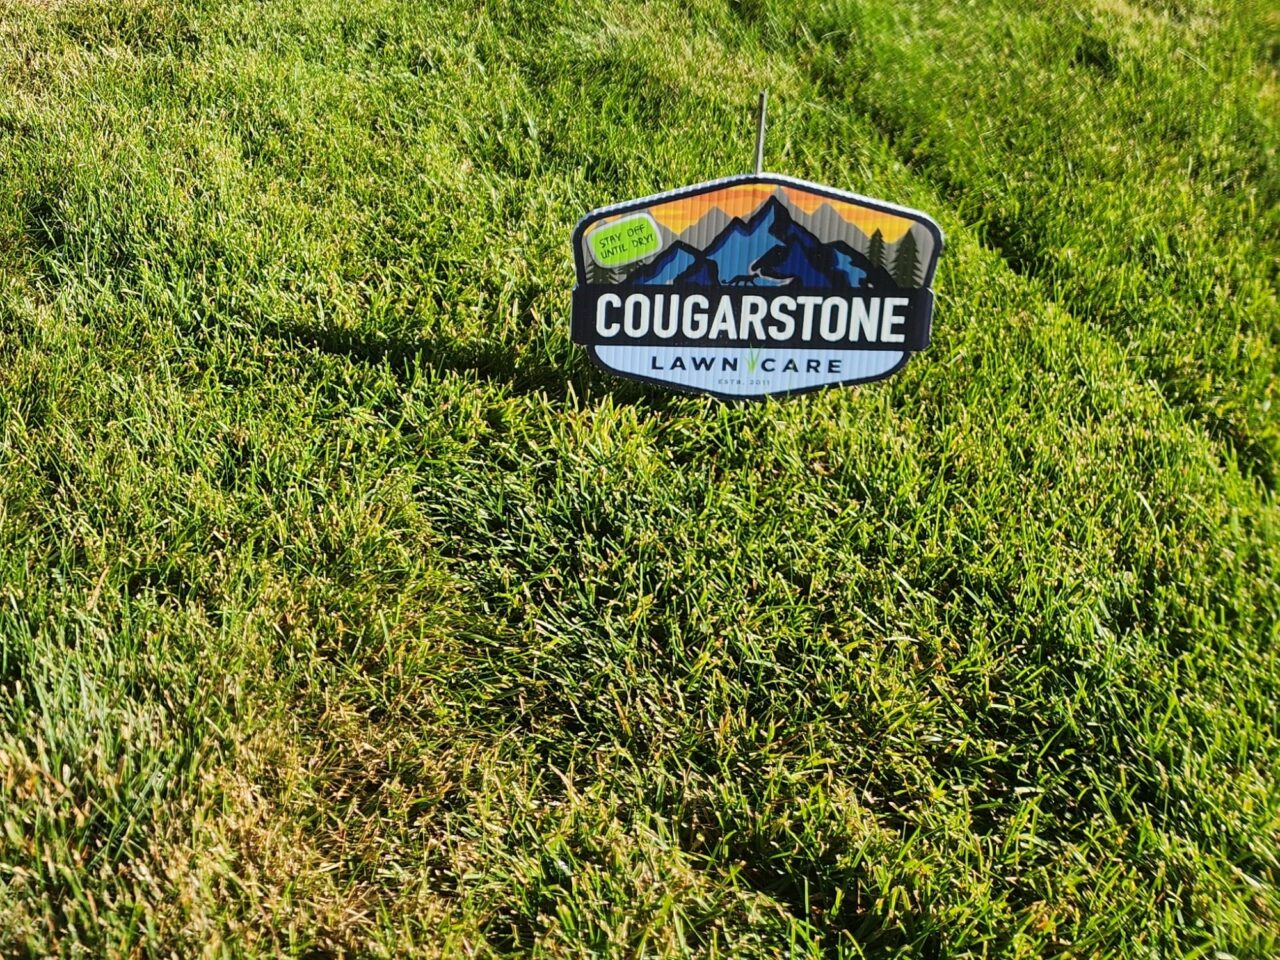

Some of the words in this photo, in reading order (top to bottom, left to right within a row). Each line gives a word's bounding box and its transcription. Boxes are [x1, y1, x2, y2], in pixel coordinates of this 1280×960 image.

[600, 233, 622, 248] STAY
[627, 224, 645, 237] OFF
[601, 243, 628, 259] UNTIL
[632, 234, 654, 248] DRY!
[595, 293, 909, 342] COUGARSTONE
[651, 355, 738, 372] LAWN
[761, 358, 842, 374] CARE
